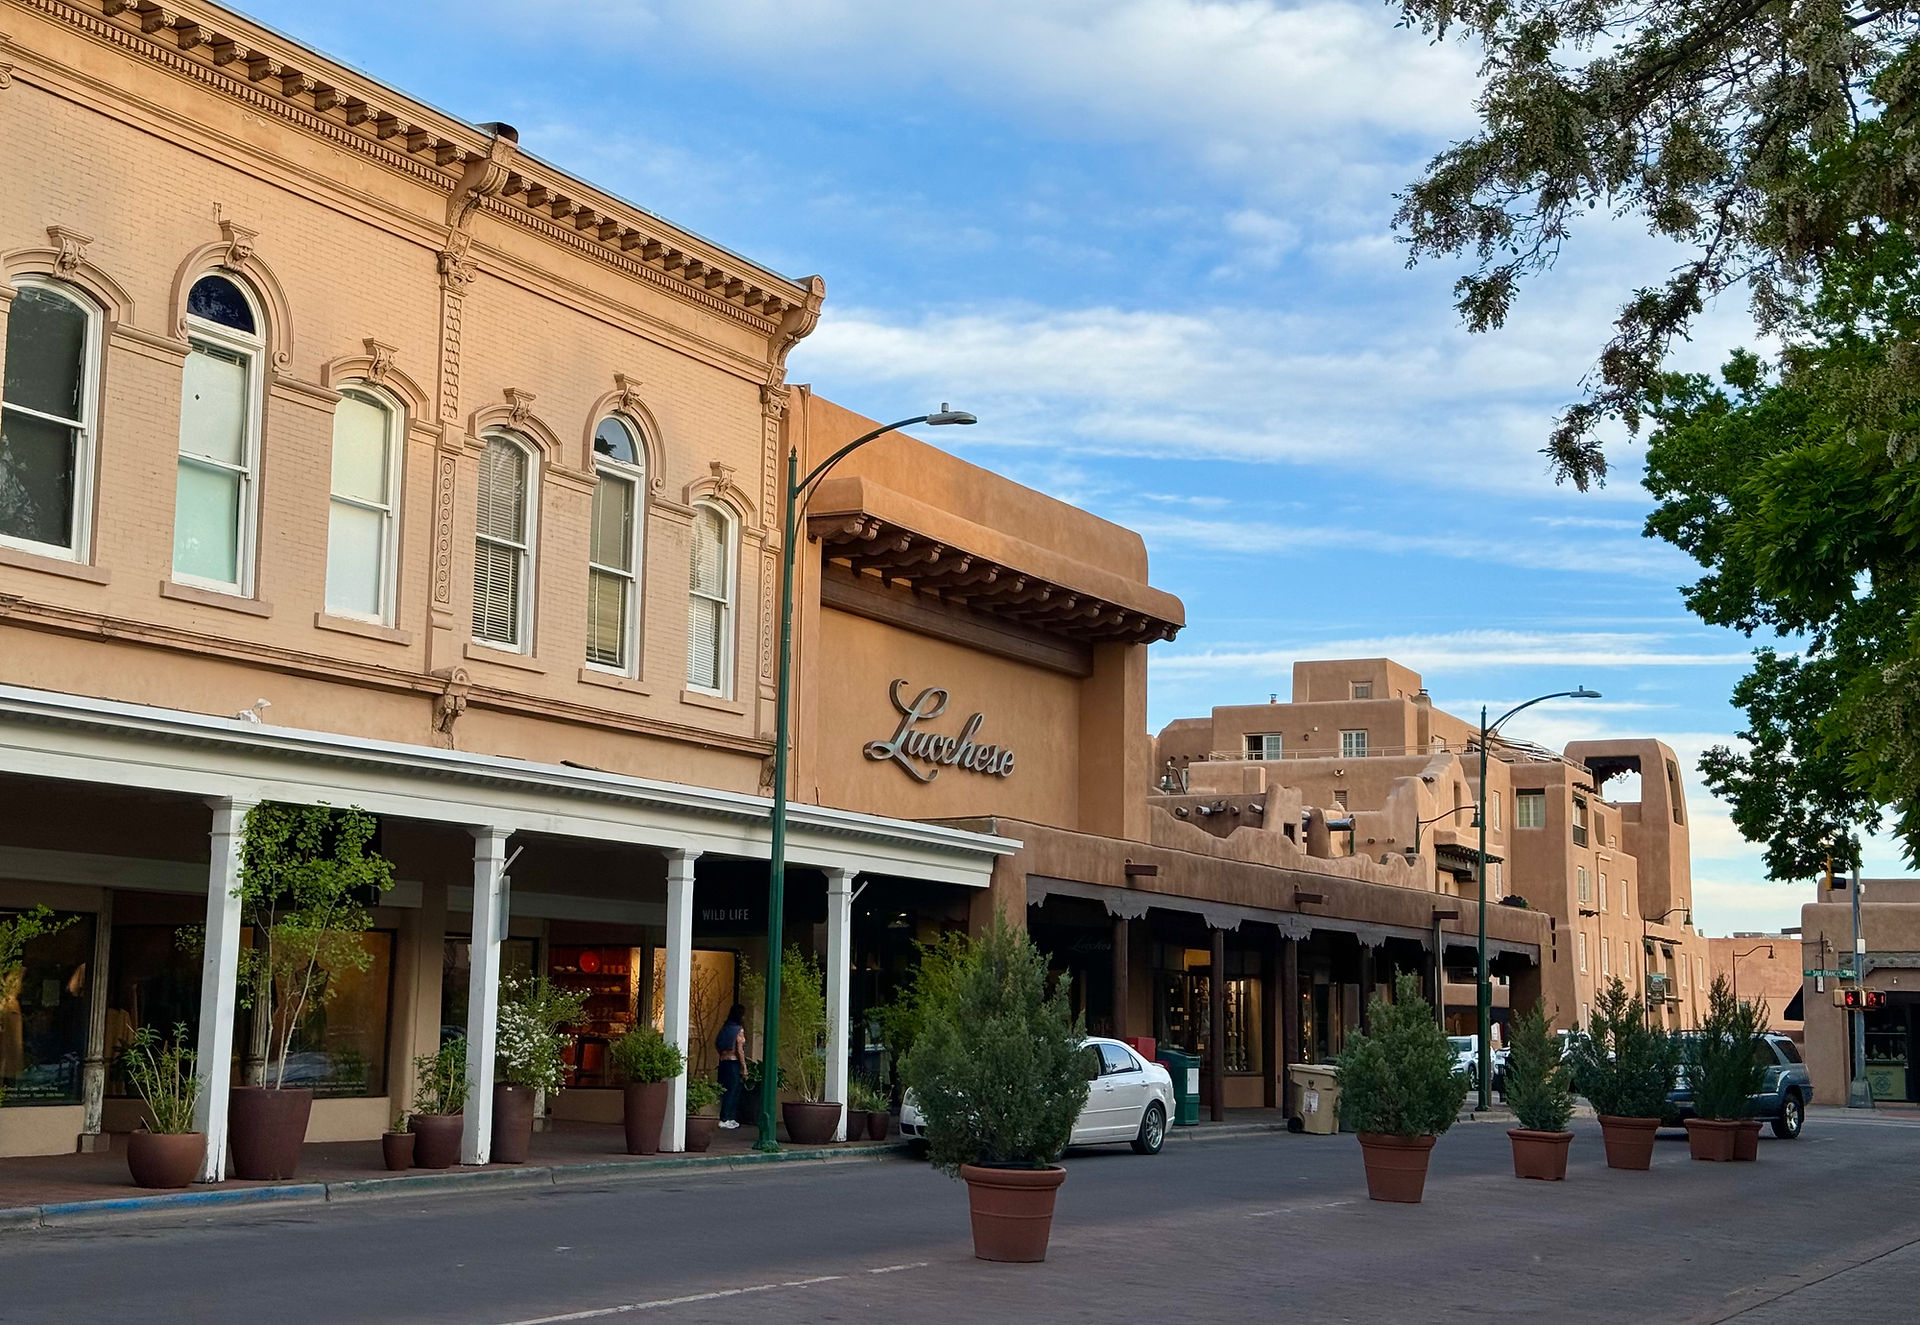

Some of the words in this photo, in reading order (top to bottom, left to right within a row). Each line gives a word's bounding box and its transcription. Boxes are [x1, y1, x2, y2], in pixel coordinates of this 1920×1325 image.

[863, 679, 1015, 783] Lucchese
[702, 909, 725, 921] WILD
[729, 909, 750, 921] LIFE
